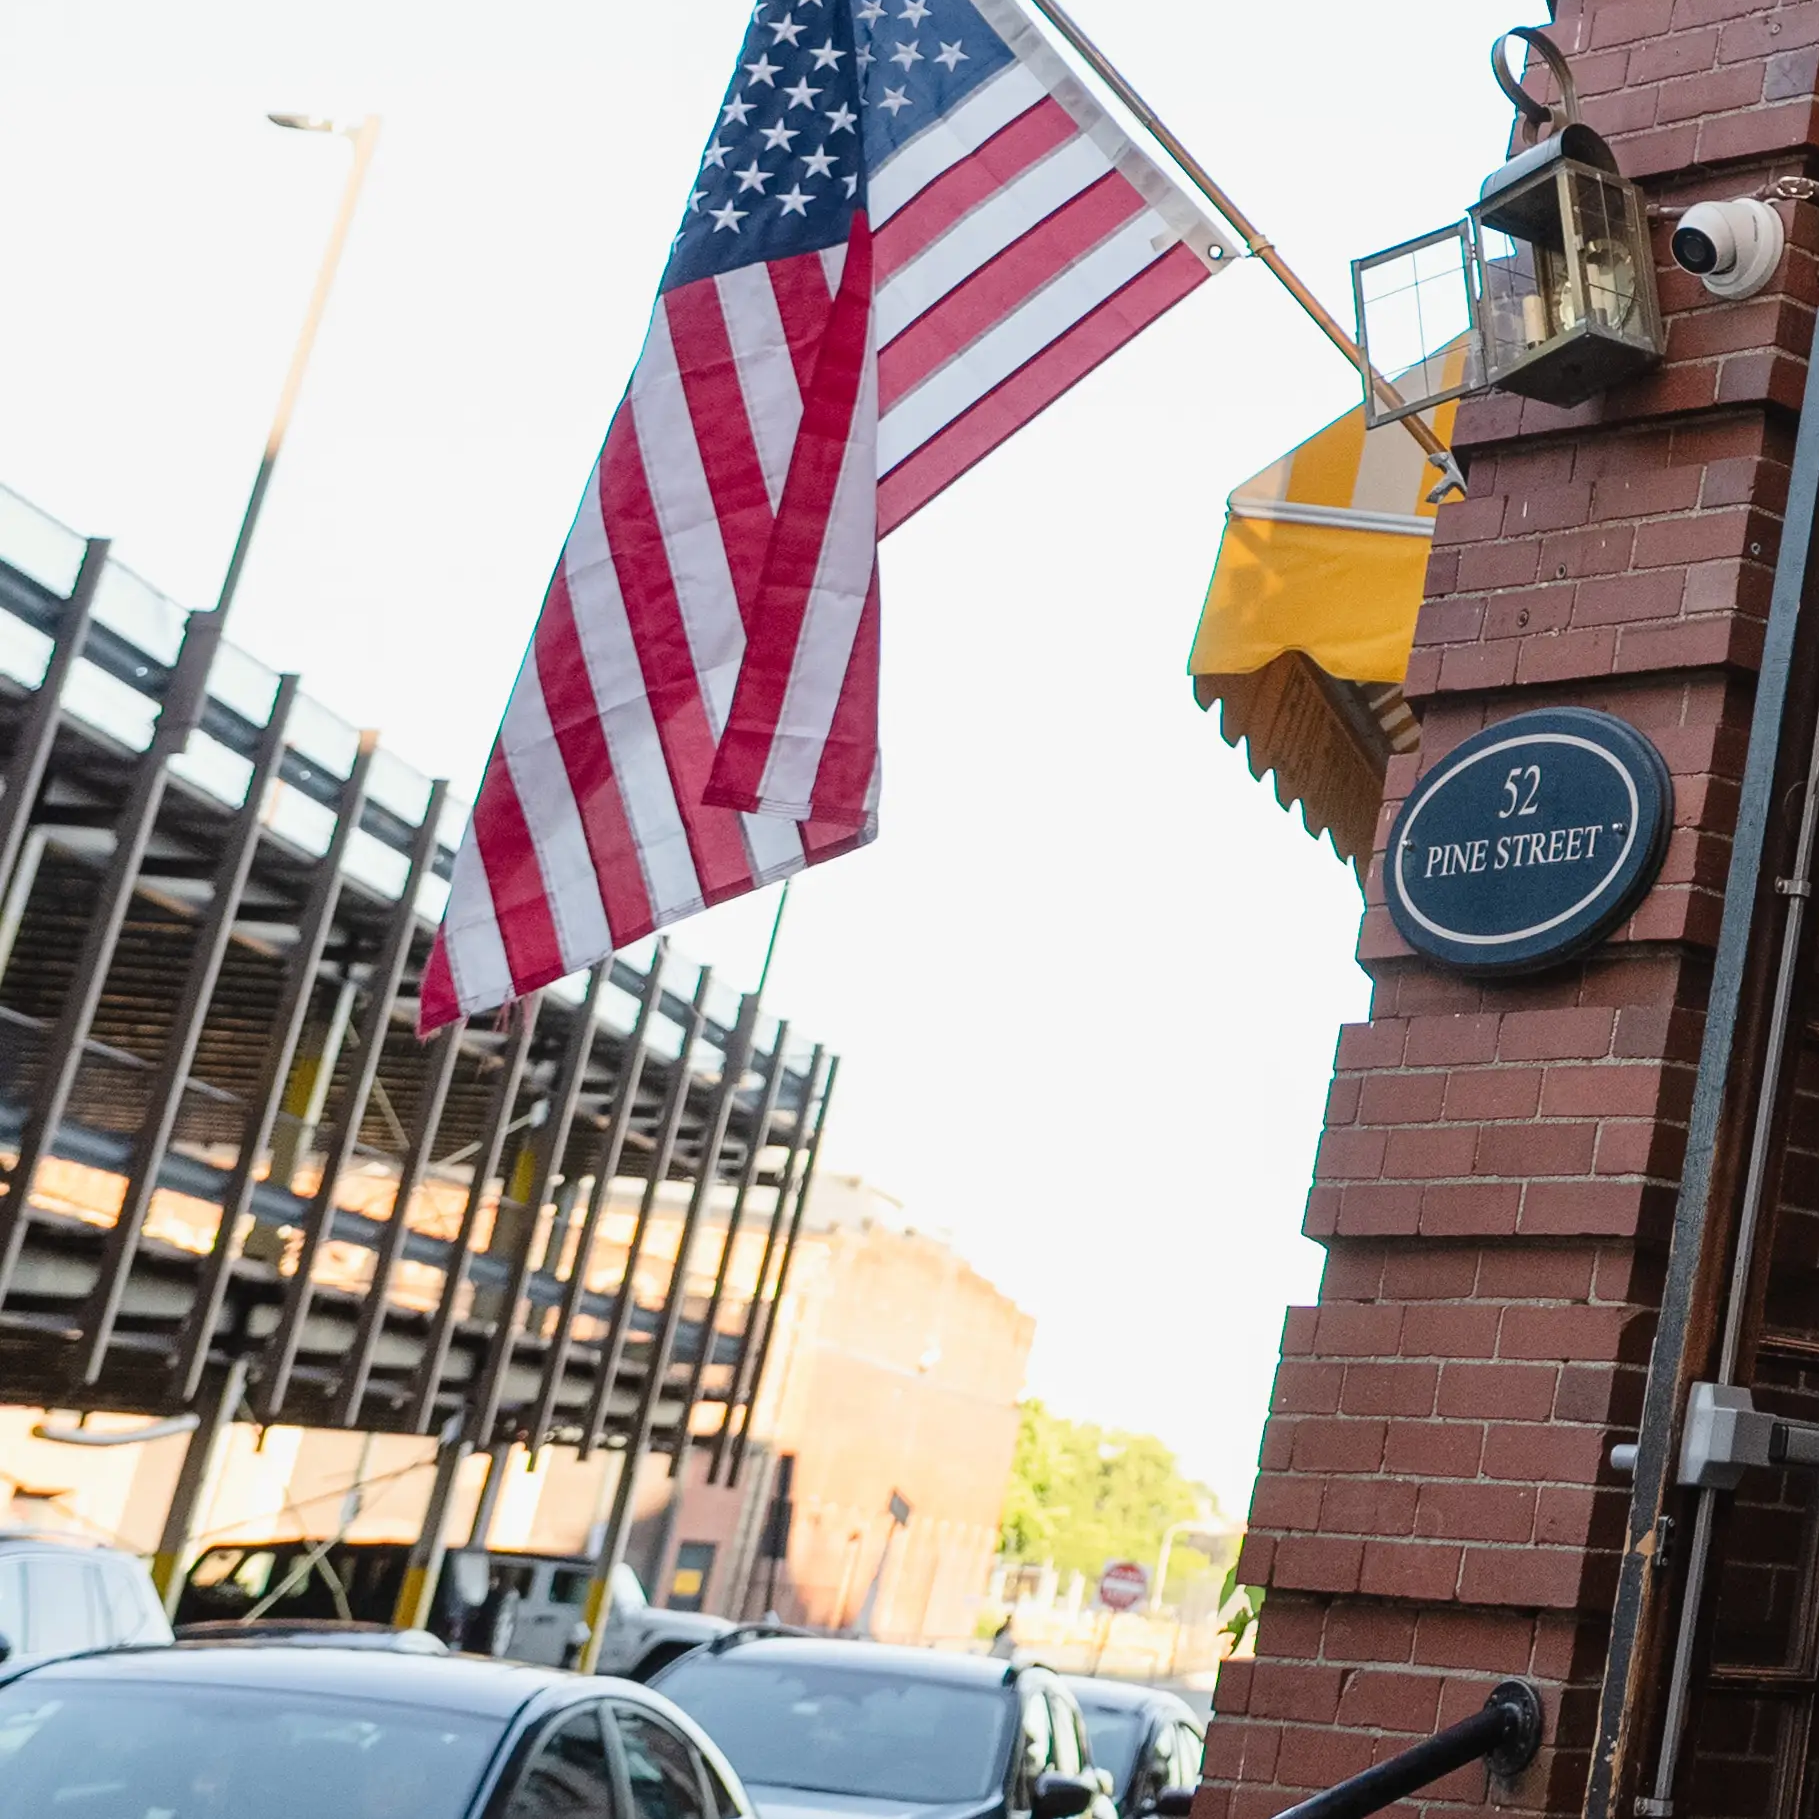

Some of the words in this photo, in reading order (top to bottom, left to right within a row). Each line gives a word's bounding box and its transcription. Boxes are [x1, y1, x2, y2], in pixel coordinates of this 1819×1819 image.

[1498, 765, 1542, 819] 52
[1424, 839, 1489, 879] PINE
[1494, 824, 1603, 870] STREET
